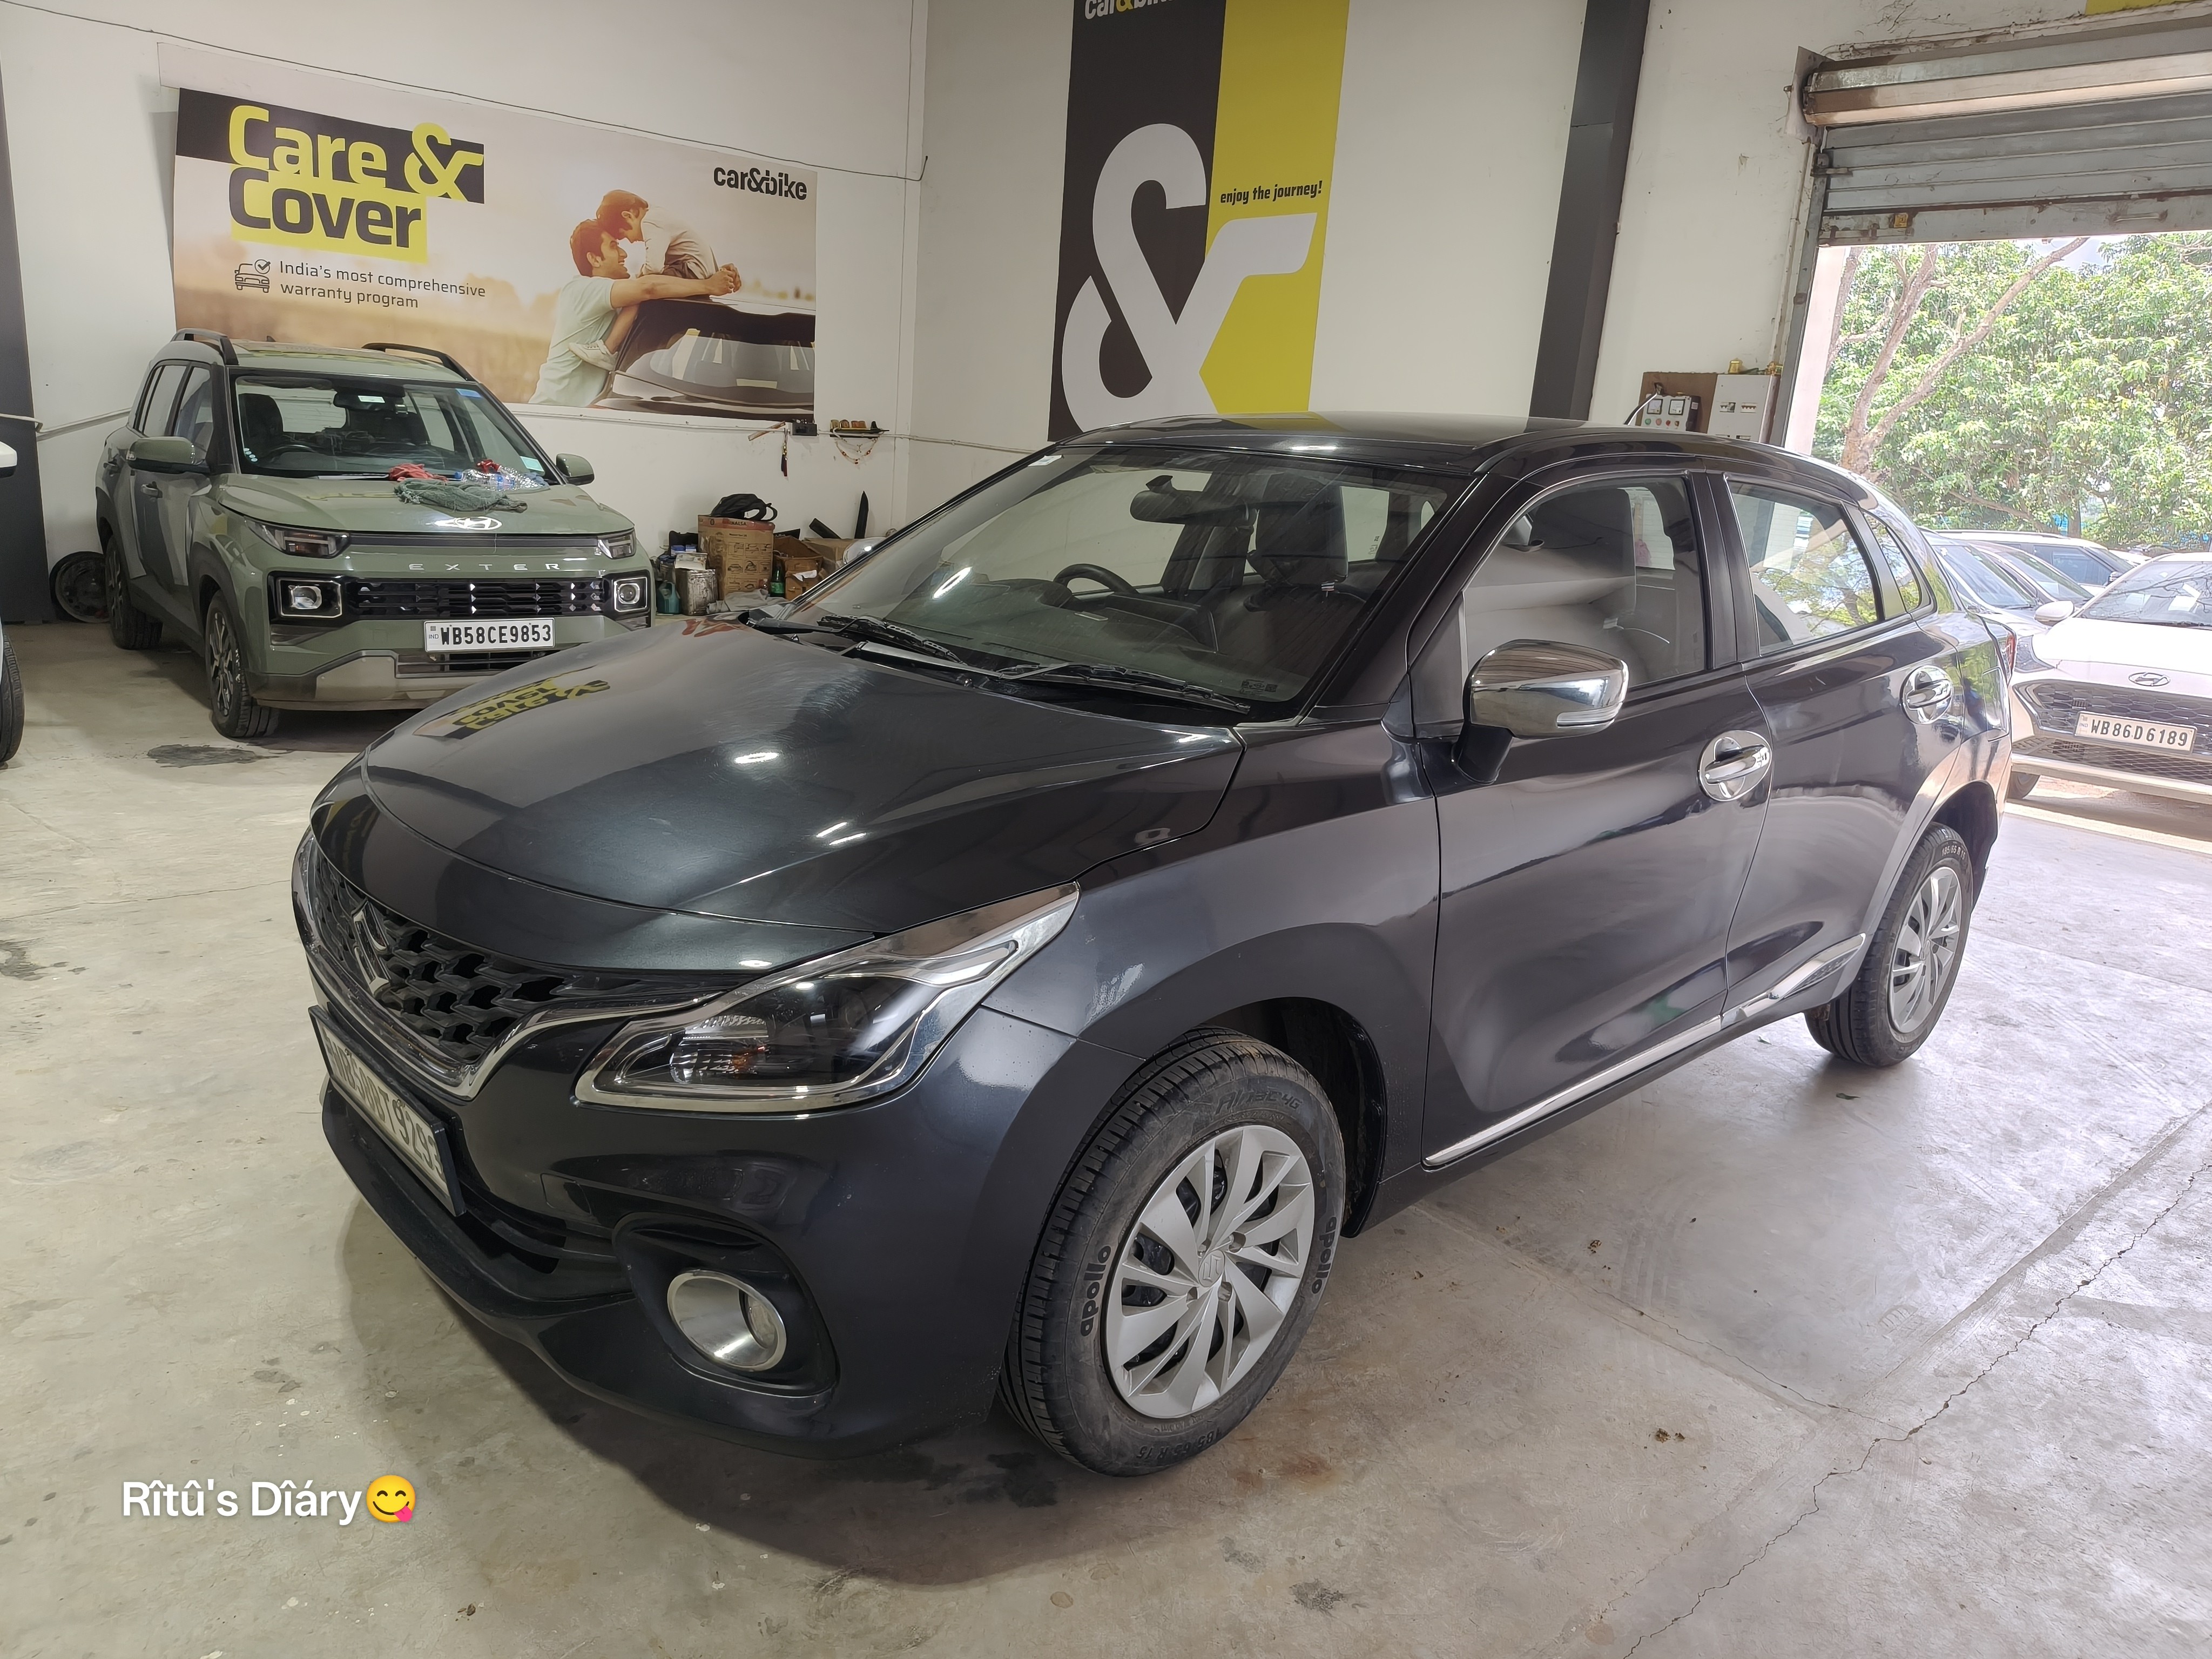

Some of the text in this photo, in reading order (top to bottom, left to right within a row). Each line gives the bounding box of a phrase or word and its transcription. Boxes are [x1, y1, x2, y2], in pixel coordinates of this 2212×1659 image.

[229, 105, 484, 202] Care &
[713, 167, 807, 200] car&bike
[1220, 180, 1323, 206] enjoy the journey!
[229, 167, 421, 248] Cover
[280, 260, 486, 297] India's most comprehensive
[280, 284, 419, 308] warranty program
[440, 624, 551, 645] WB58CE9853
[2090, 719, 2188, 746] WB86D6189
[1311, 1216, 1337, 1294] apollo
[1081, 1245, 1111, 1337] apollo
